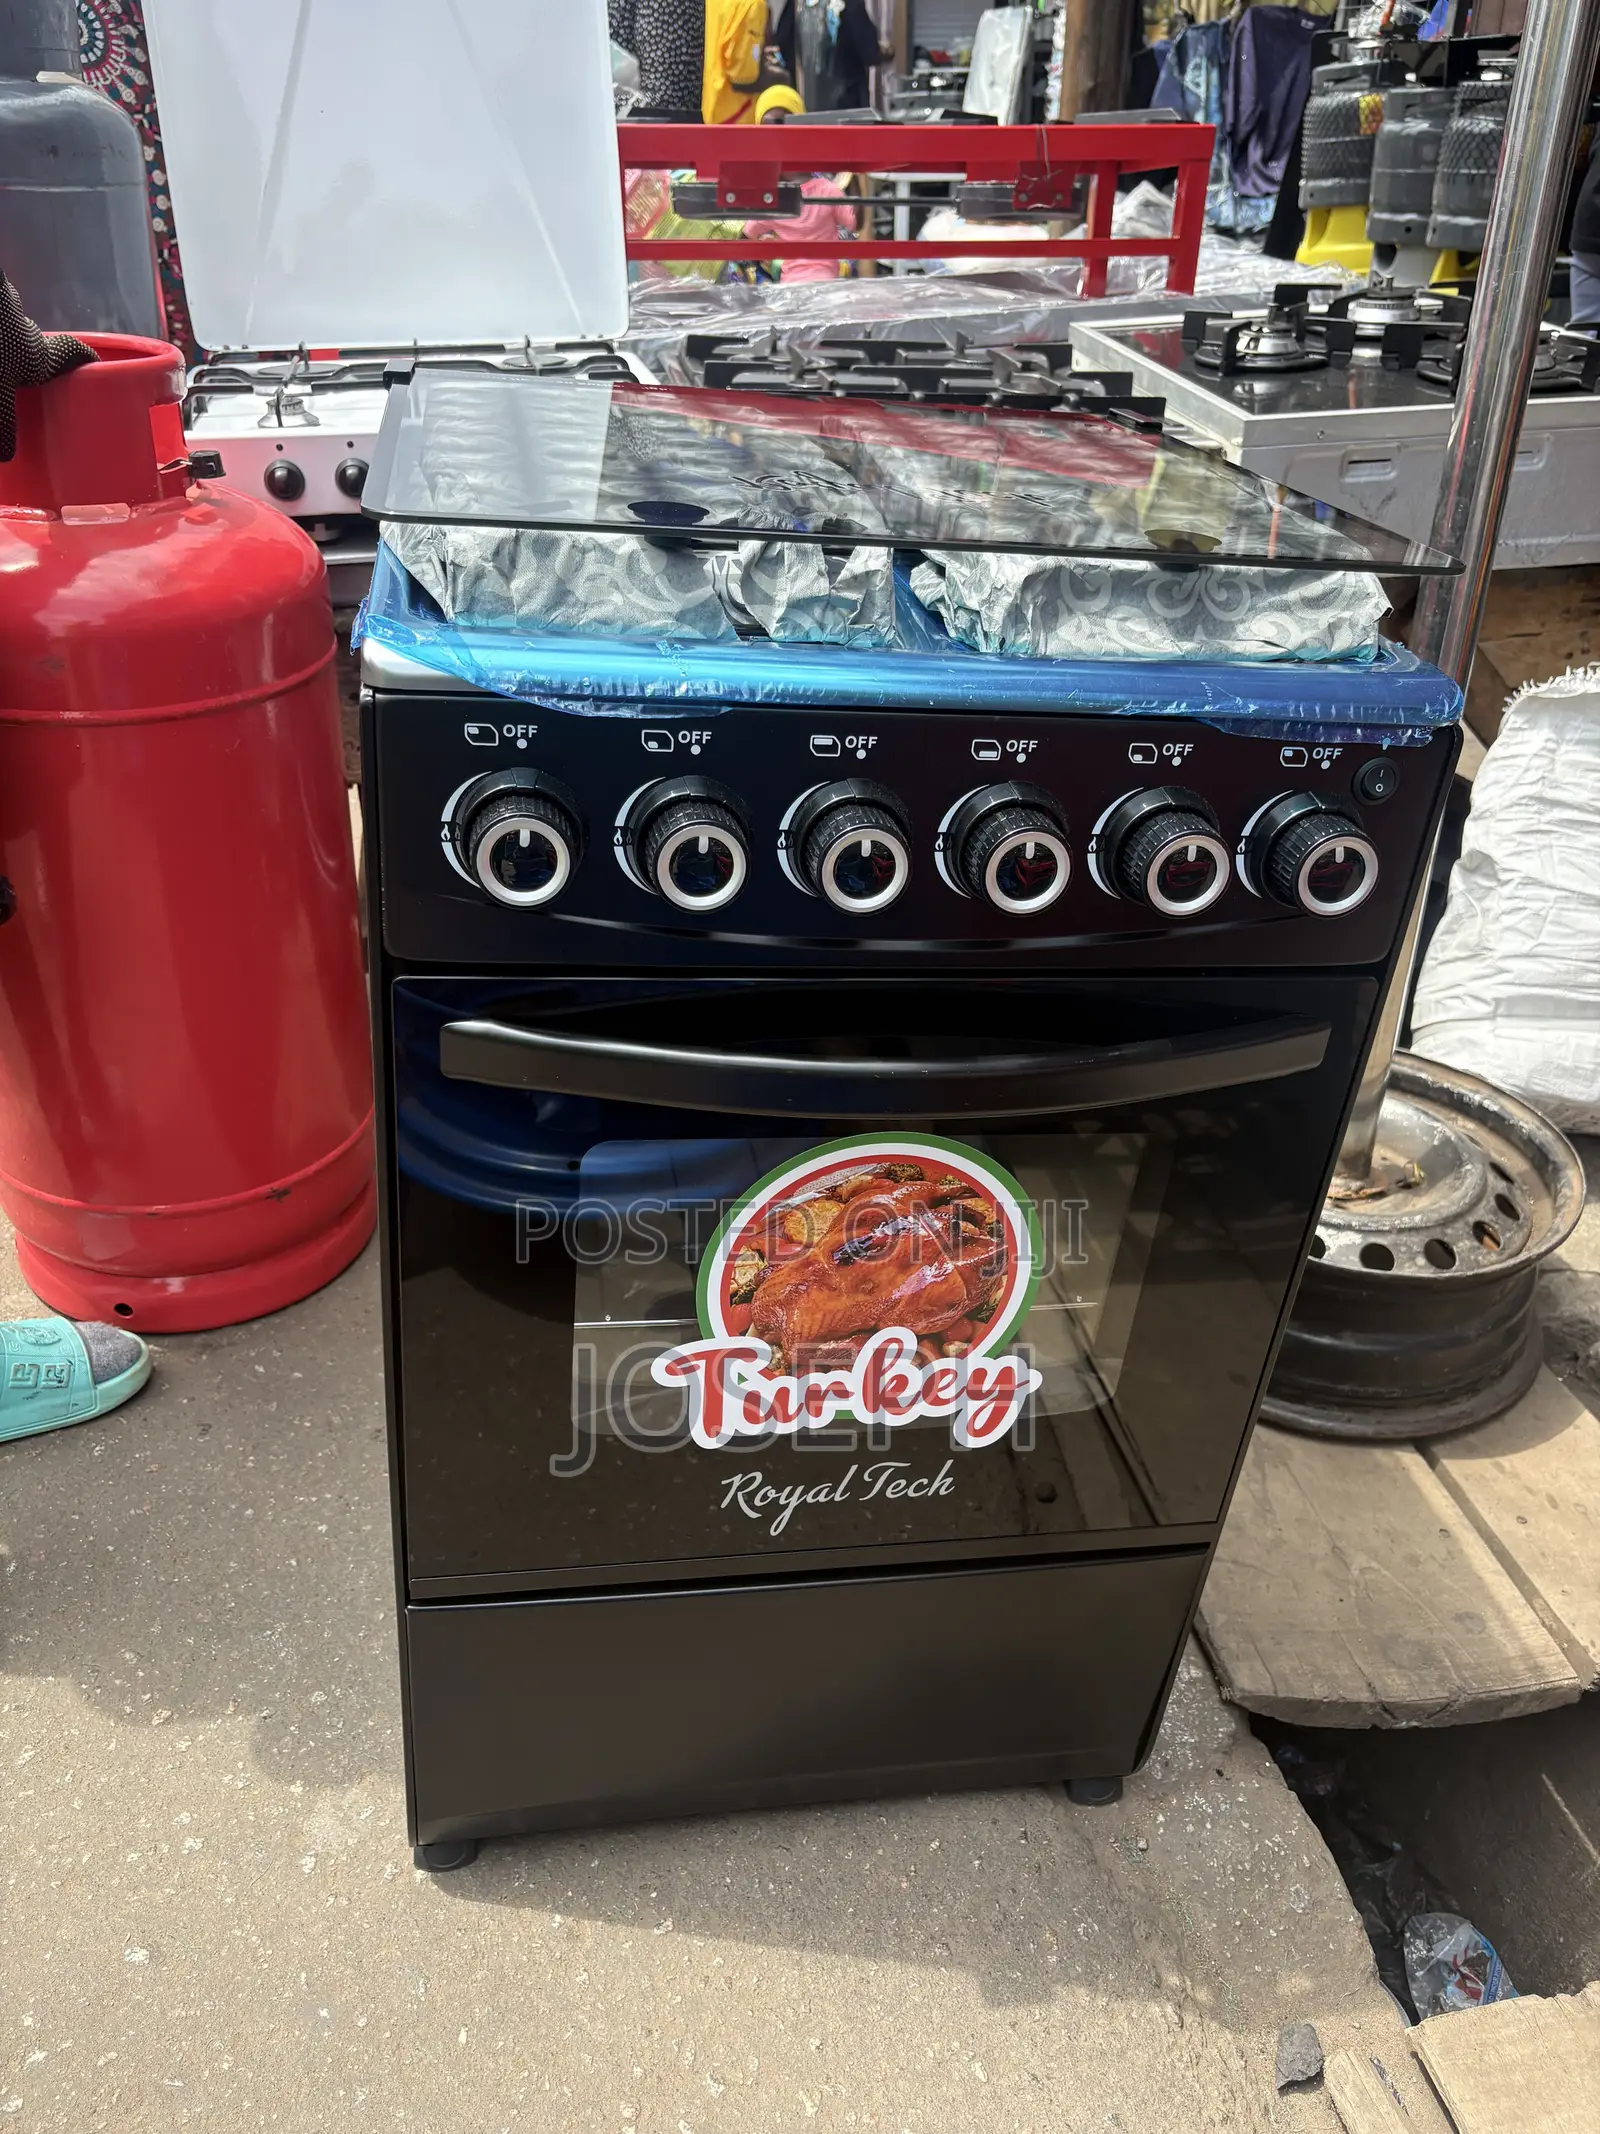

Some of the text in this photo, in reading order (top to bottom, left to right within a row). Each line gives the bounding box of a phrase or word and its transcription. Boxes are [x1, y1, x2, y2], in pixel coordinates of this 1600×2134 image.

[502, 723, 538, 738] OFF
[677, 730, 712, 745] OFF
[844, 735, 878, 749] OFF
[1005, 739, 1039, 753] OFF
[1162, 743, 1194, 756] OFF
[1312, 747, 1343, 760] OFF
[662, 1335, 1030, 1441] Turkey
[721, 1460, 955, 1536] Royal Tech
